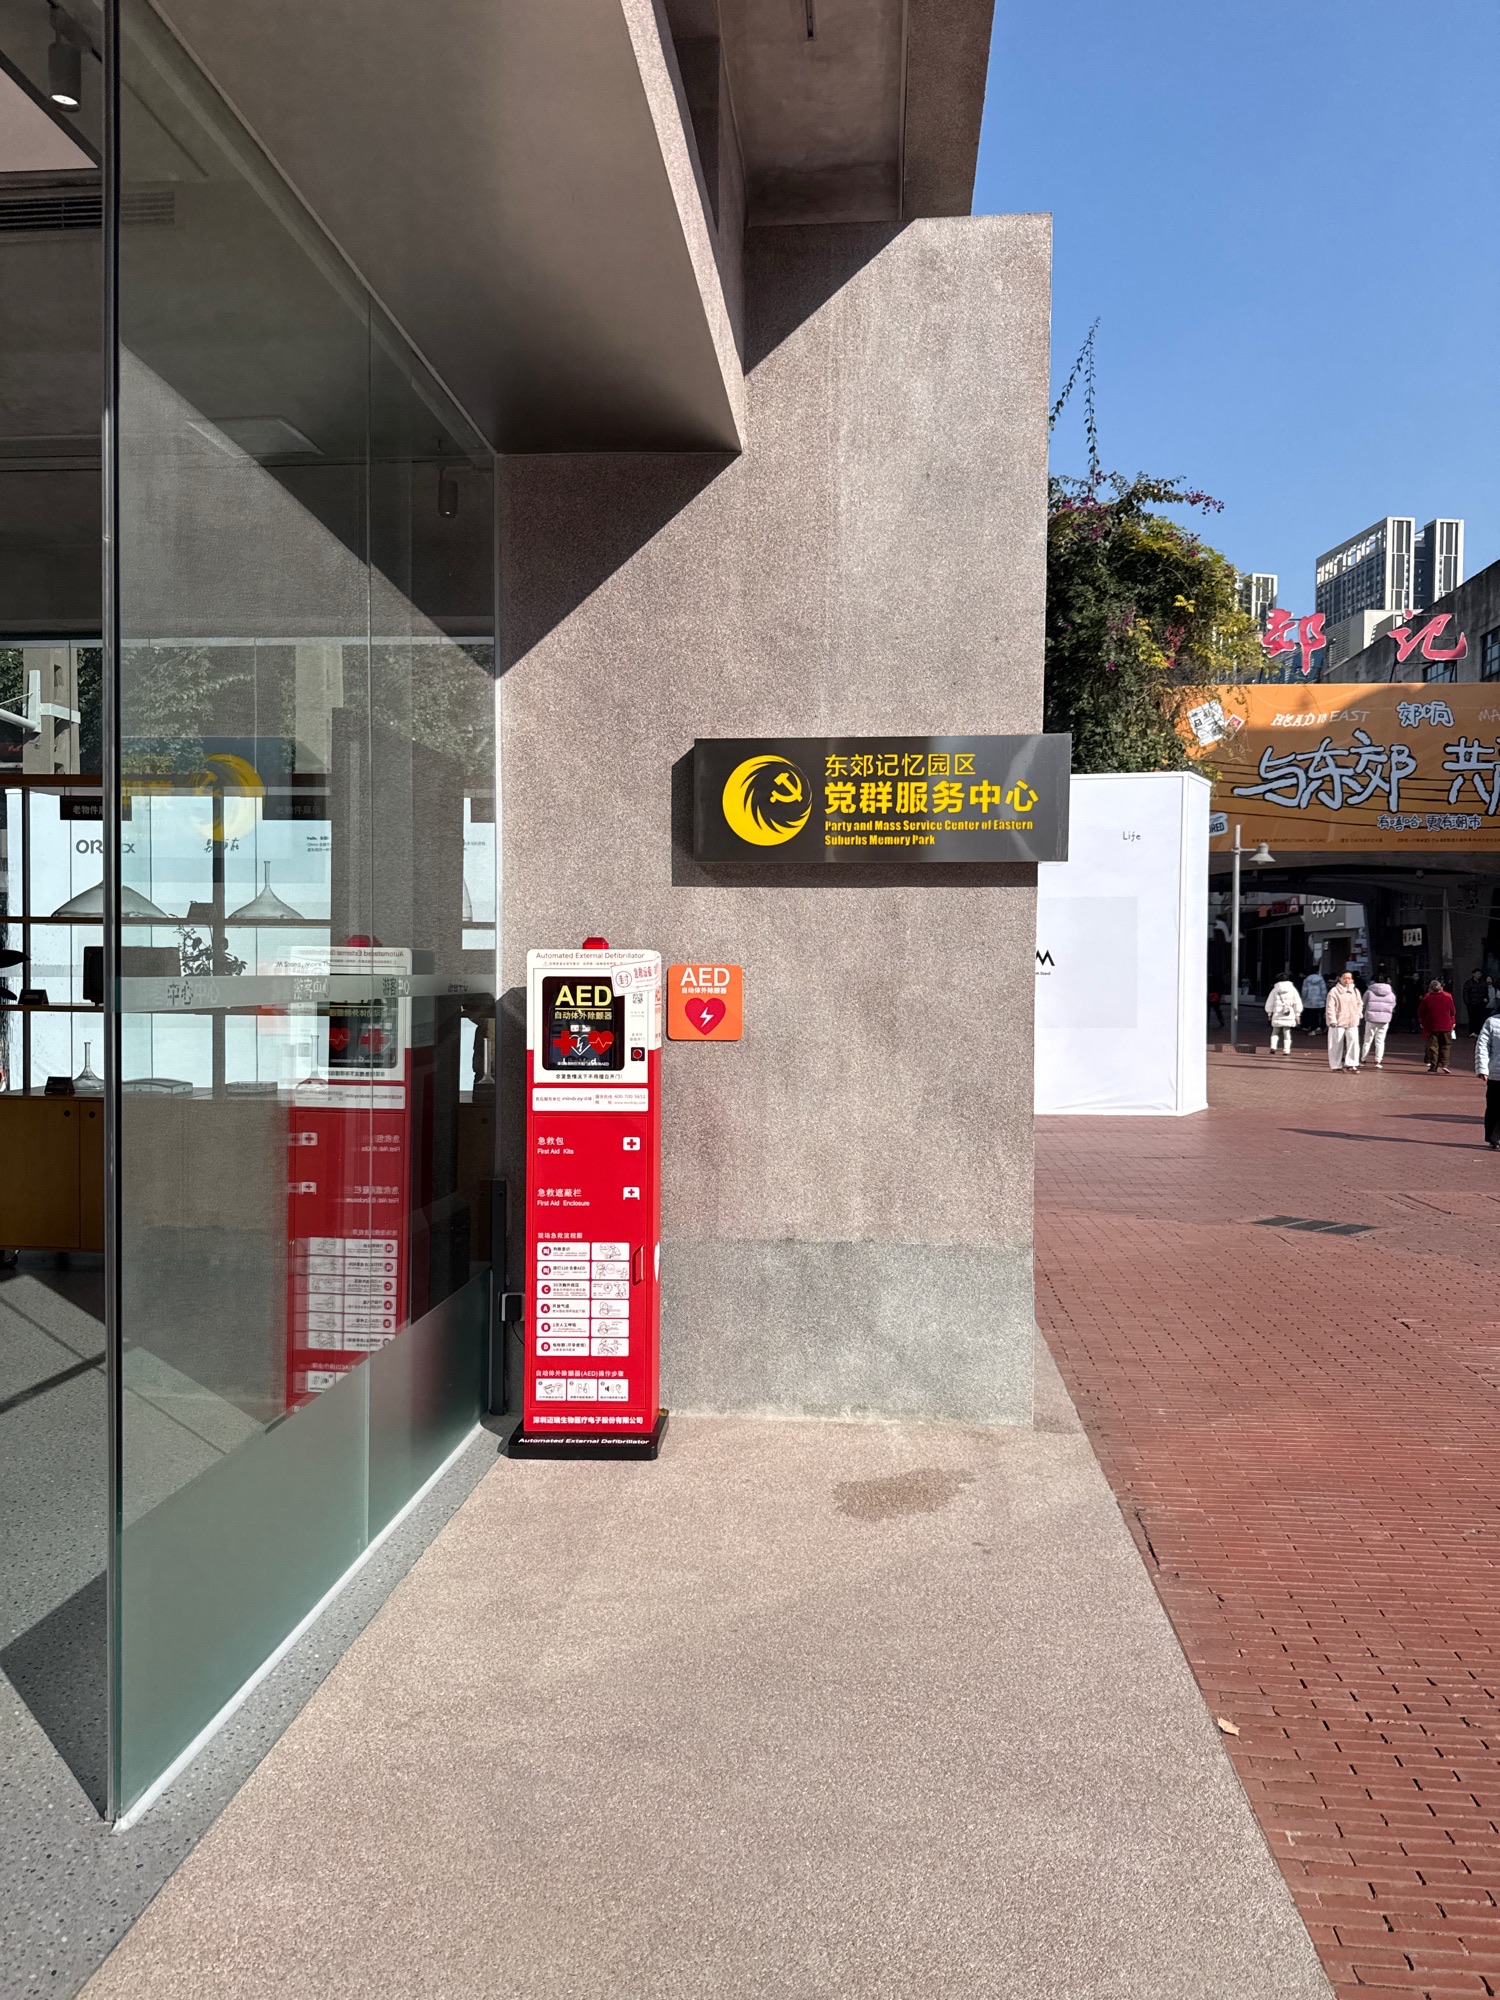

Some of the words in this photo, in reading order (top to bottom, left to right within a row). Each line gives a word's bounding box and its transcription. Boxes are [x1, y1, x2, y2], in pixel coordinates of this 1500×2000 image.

[1329, 709, 1370, 722] EAST
[825, 753, 976, 777] 东郊记忆园区
[824, 780, 1039, 814] 党群服务中心
[825, 820, 852, 832] Party
[853, 820, 873, 831] and
[875, 820, 901, 831] Mass
[903, 820, 942, 831] Service
[944, 820, 979, 830] Center
[981, 820, 992, 830] of
[993, 820, 1033, 830] Eastern
[825, 835, 868, 846] Suburbs
[869, 835, 911, 847] Memory
[912, 835, 935, 845] Park
[1122, 831, 1142, 842] Life
[680, 967, 730, 986] AED
[555, 985, 612, 1006] AED
[681, 987, 727, 995] 自动体外除颤器
[554, 1011, 613, 1020] 自动体外除颤器
[537, 1136, 564, 1146] 急救包
